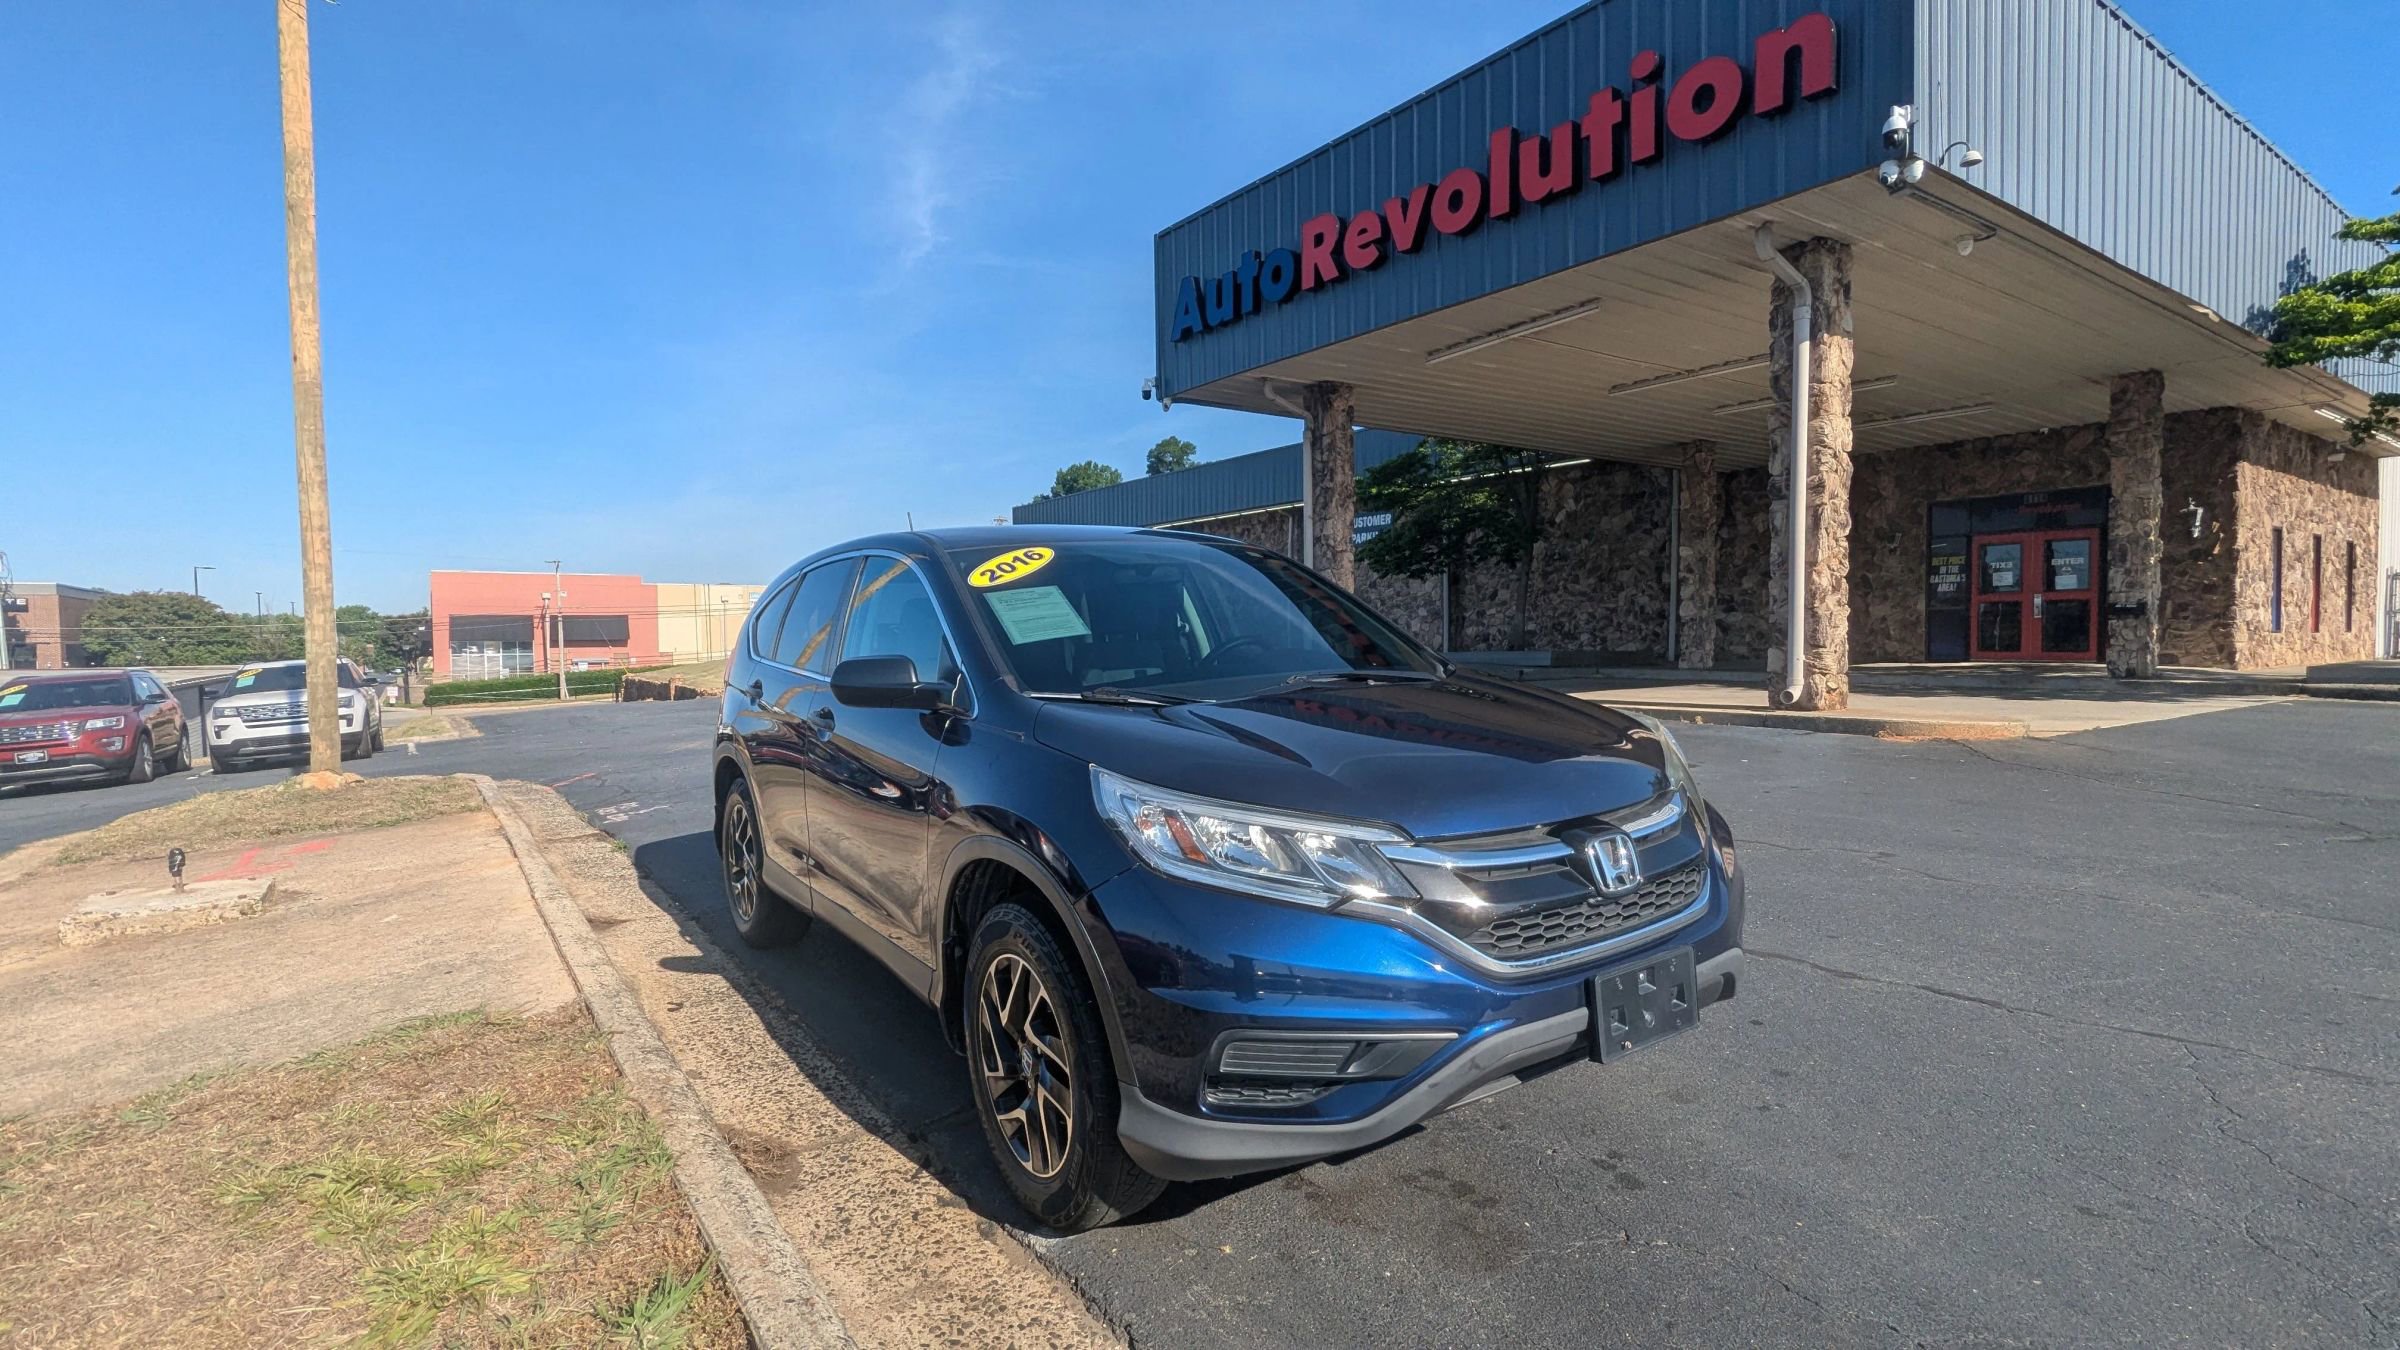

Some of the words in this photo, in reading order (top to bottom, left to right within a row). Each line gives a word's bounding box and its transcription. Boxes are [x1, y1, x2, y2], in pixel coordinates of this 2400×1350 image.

[1170, 11, 1838, 343] AutoRevolution
[1353, 513, 1392, 529] USTOMER
[1352, 531, 1379, 545] PARKI
[980, 550, 1044, 583] 2016
[2051, 557, 2085, 566] ENTER
